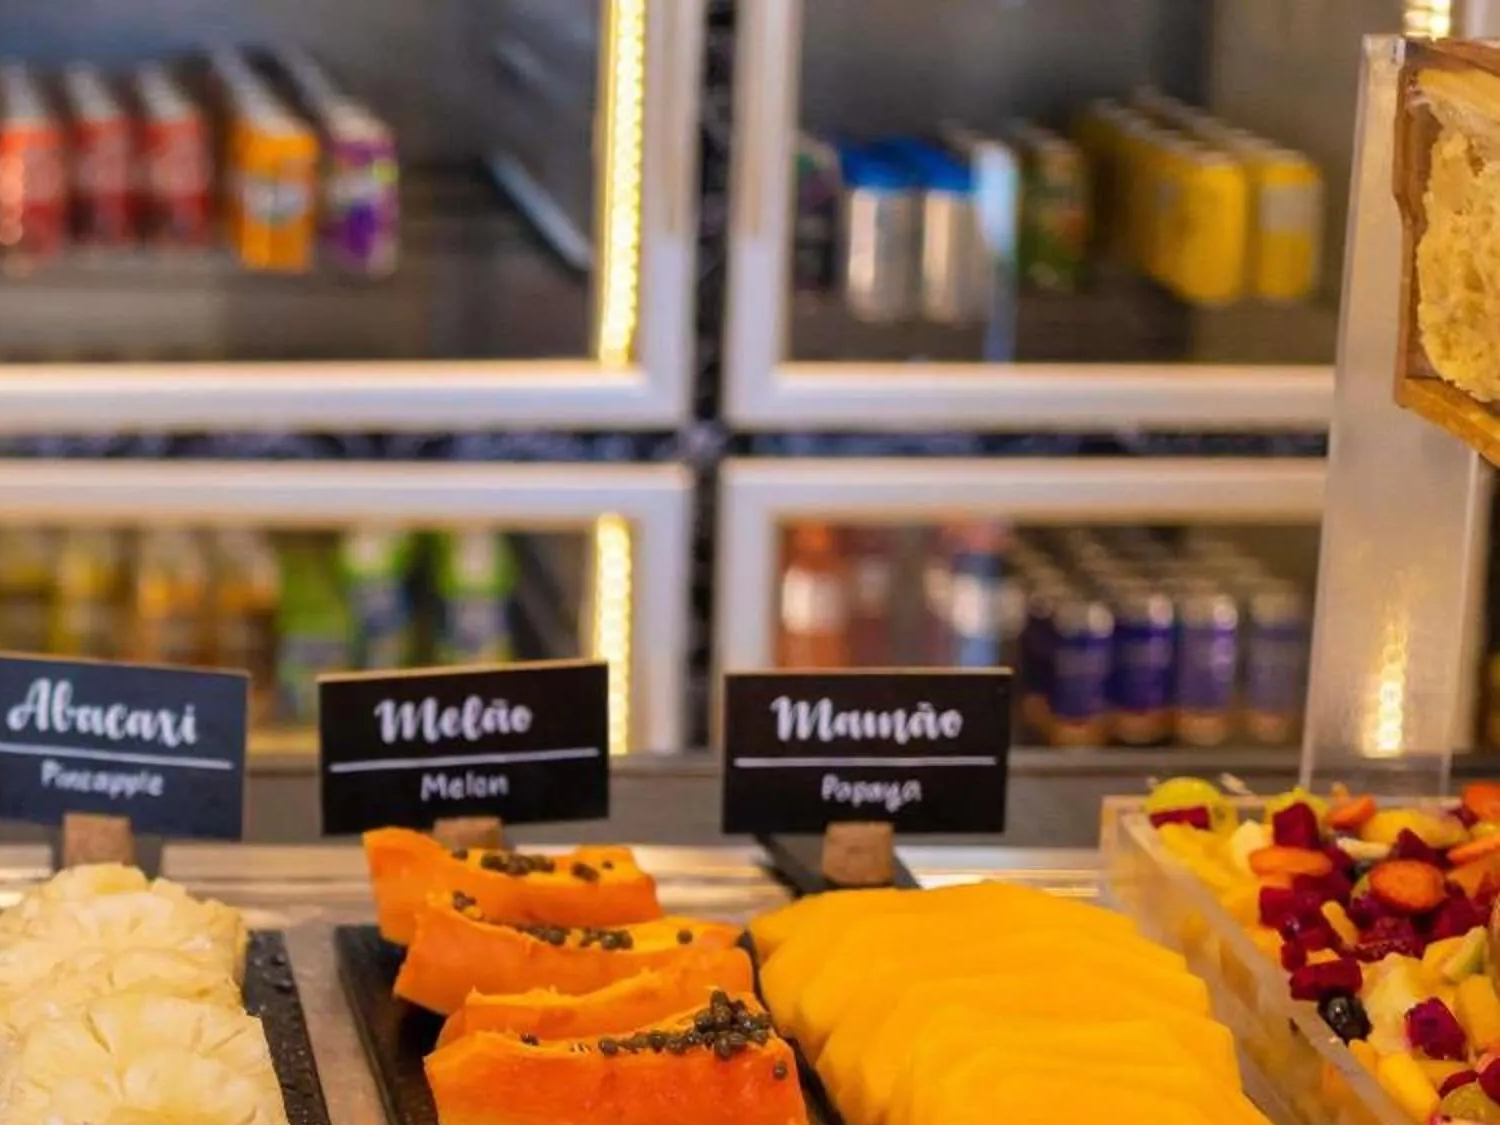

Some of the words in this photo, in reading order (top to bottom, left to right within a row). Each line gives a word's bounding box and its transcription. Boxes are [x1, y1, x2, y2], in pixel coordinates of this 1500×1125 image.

[6, 677, 197, 748] Abacaxi
[373, 694, 533, 744] Melão
[770, 695, 963, 745] Mamão
[41, 758, 164, 799] Pineapple
[420, 769, 509, 801] Melon
[821, 773, 922, 813] Papaya
